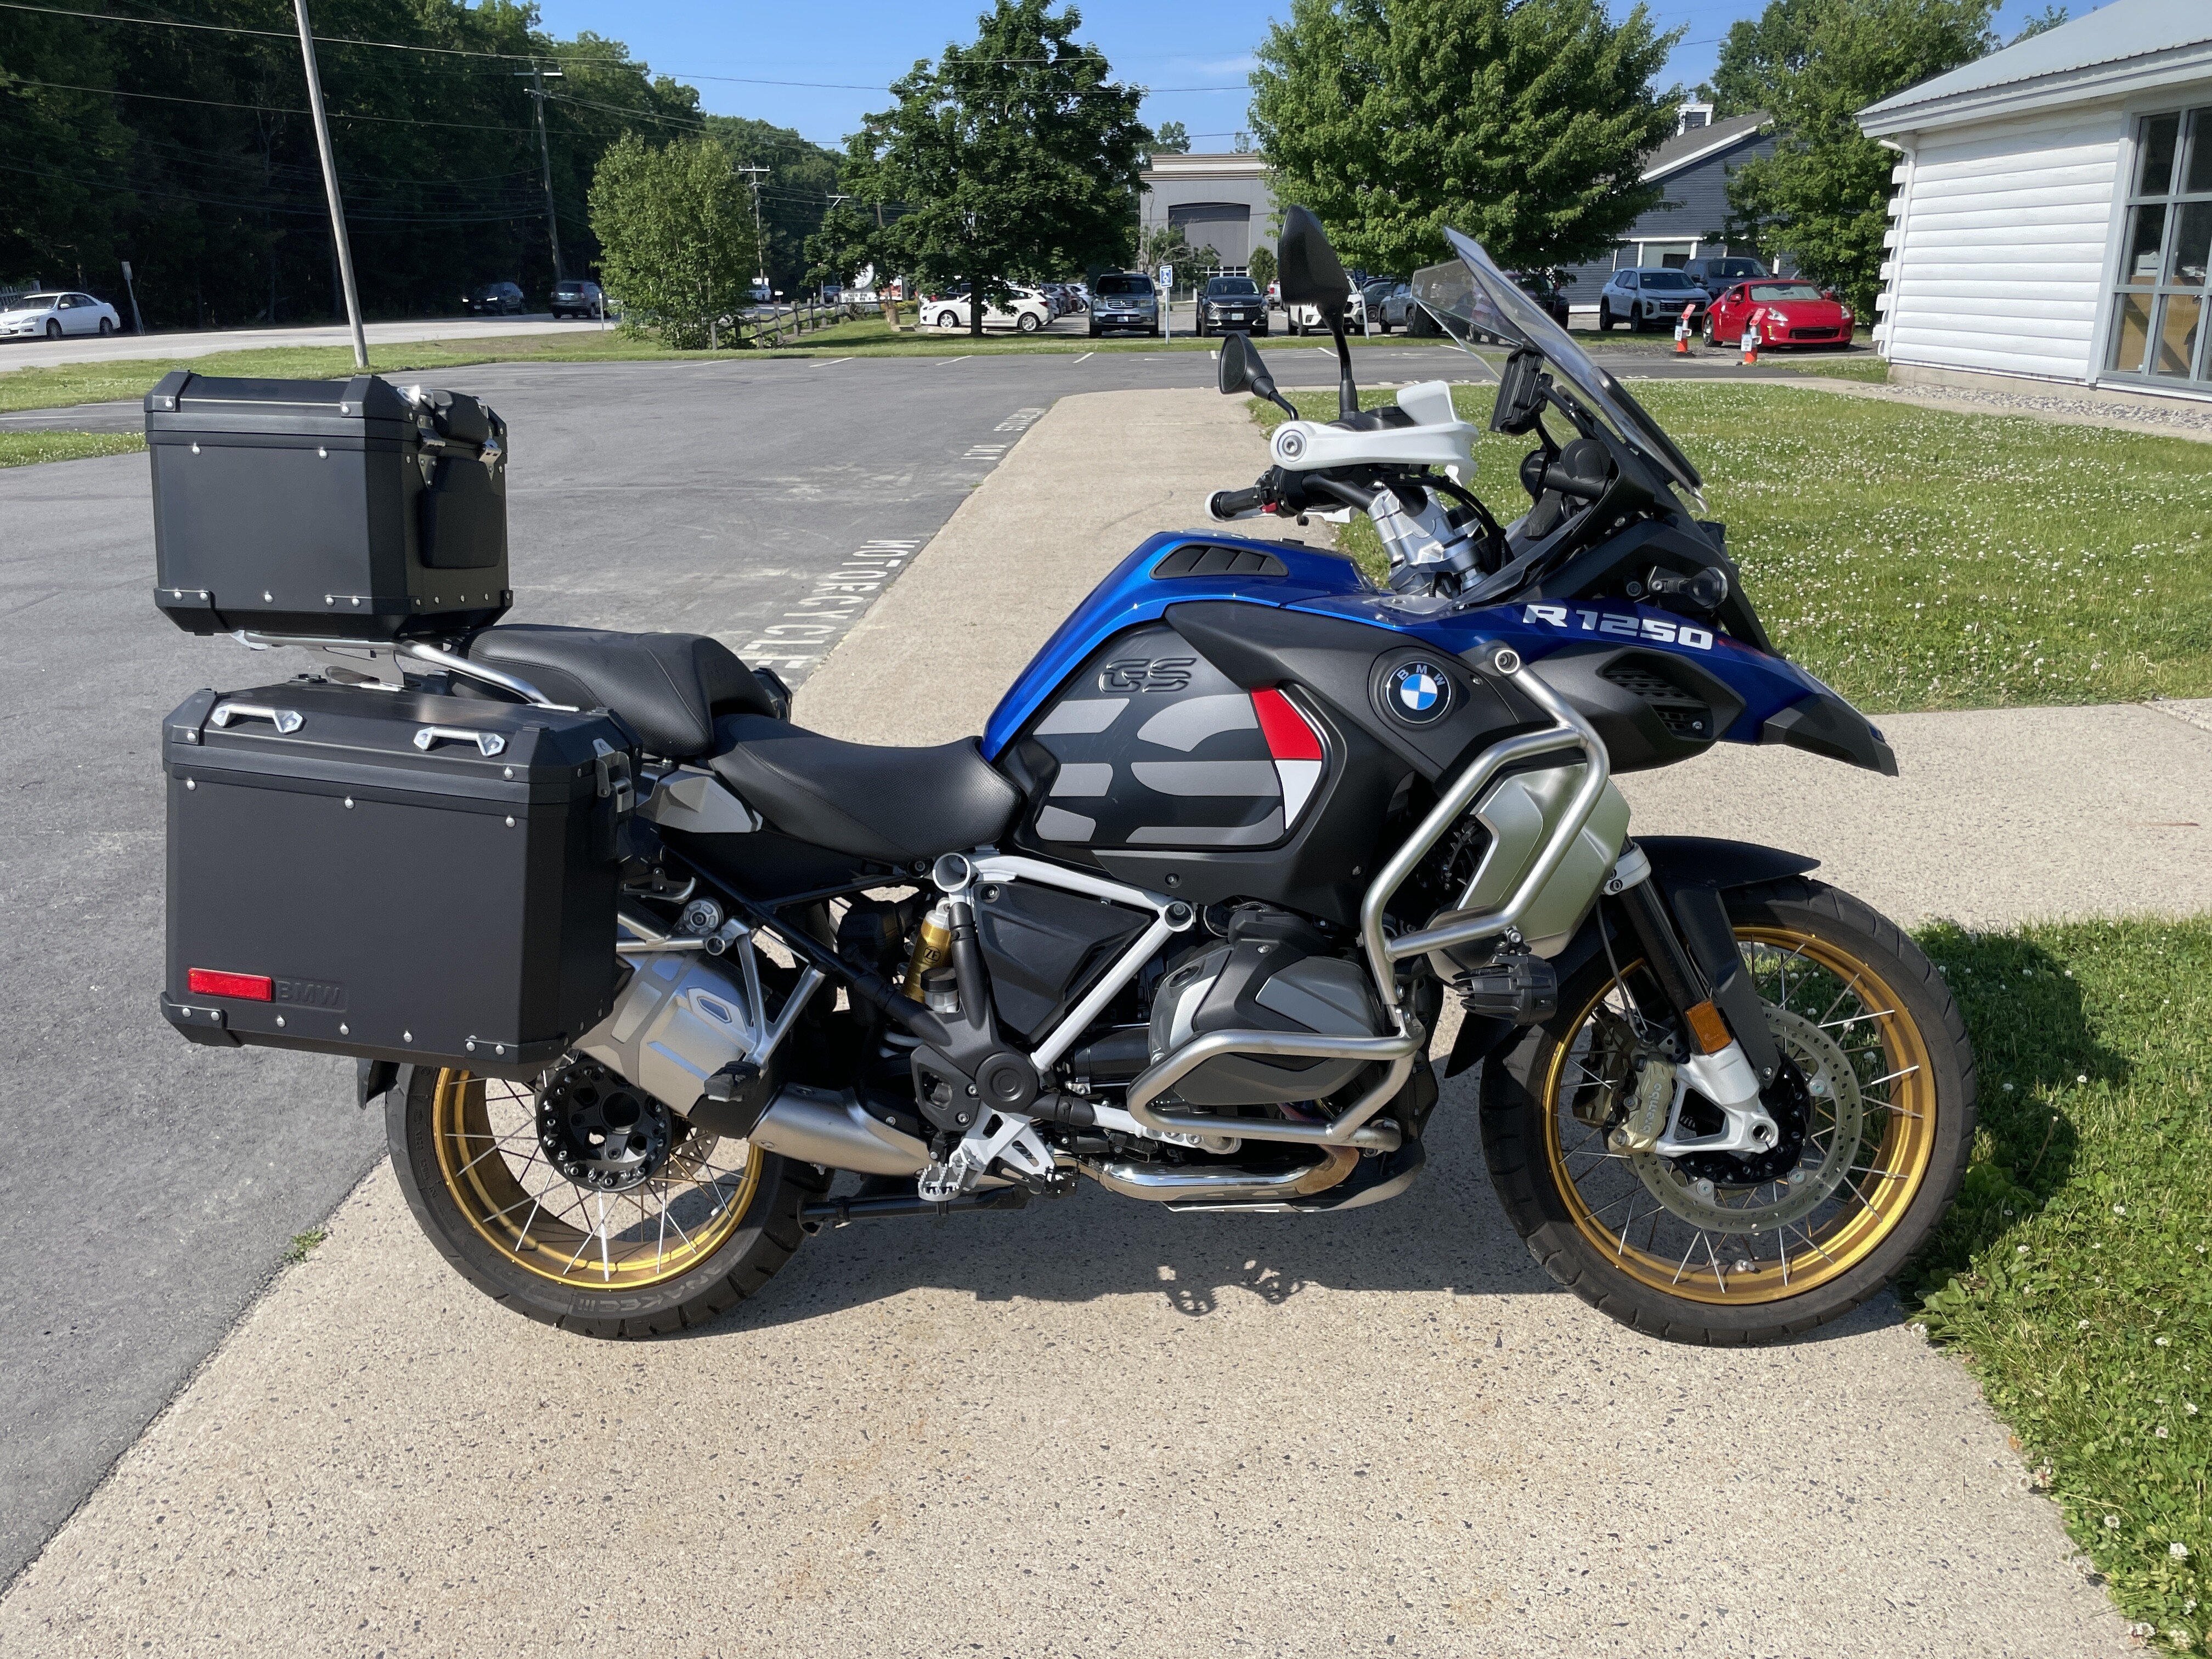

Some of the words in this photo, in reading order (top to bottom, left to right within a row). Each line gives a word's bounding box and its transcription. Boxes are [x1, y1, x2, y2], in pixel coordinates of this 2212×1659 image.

[960, 444, 1008, 460] ONLY
[737, 540, 921, 684] MOTORCYCLE
[1522, 604, 1568, 628] R
[1576, 609, 1713, 651] 1250
[1098, 658, 1197, 692] GS
[1396, 664, 1446, 686] BMW
[924, 947, 941, 962] ZF
[276, 980, 340, 1006] BMW
[1639, 1082, 1662, 1133] brembo
